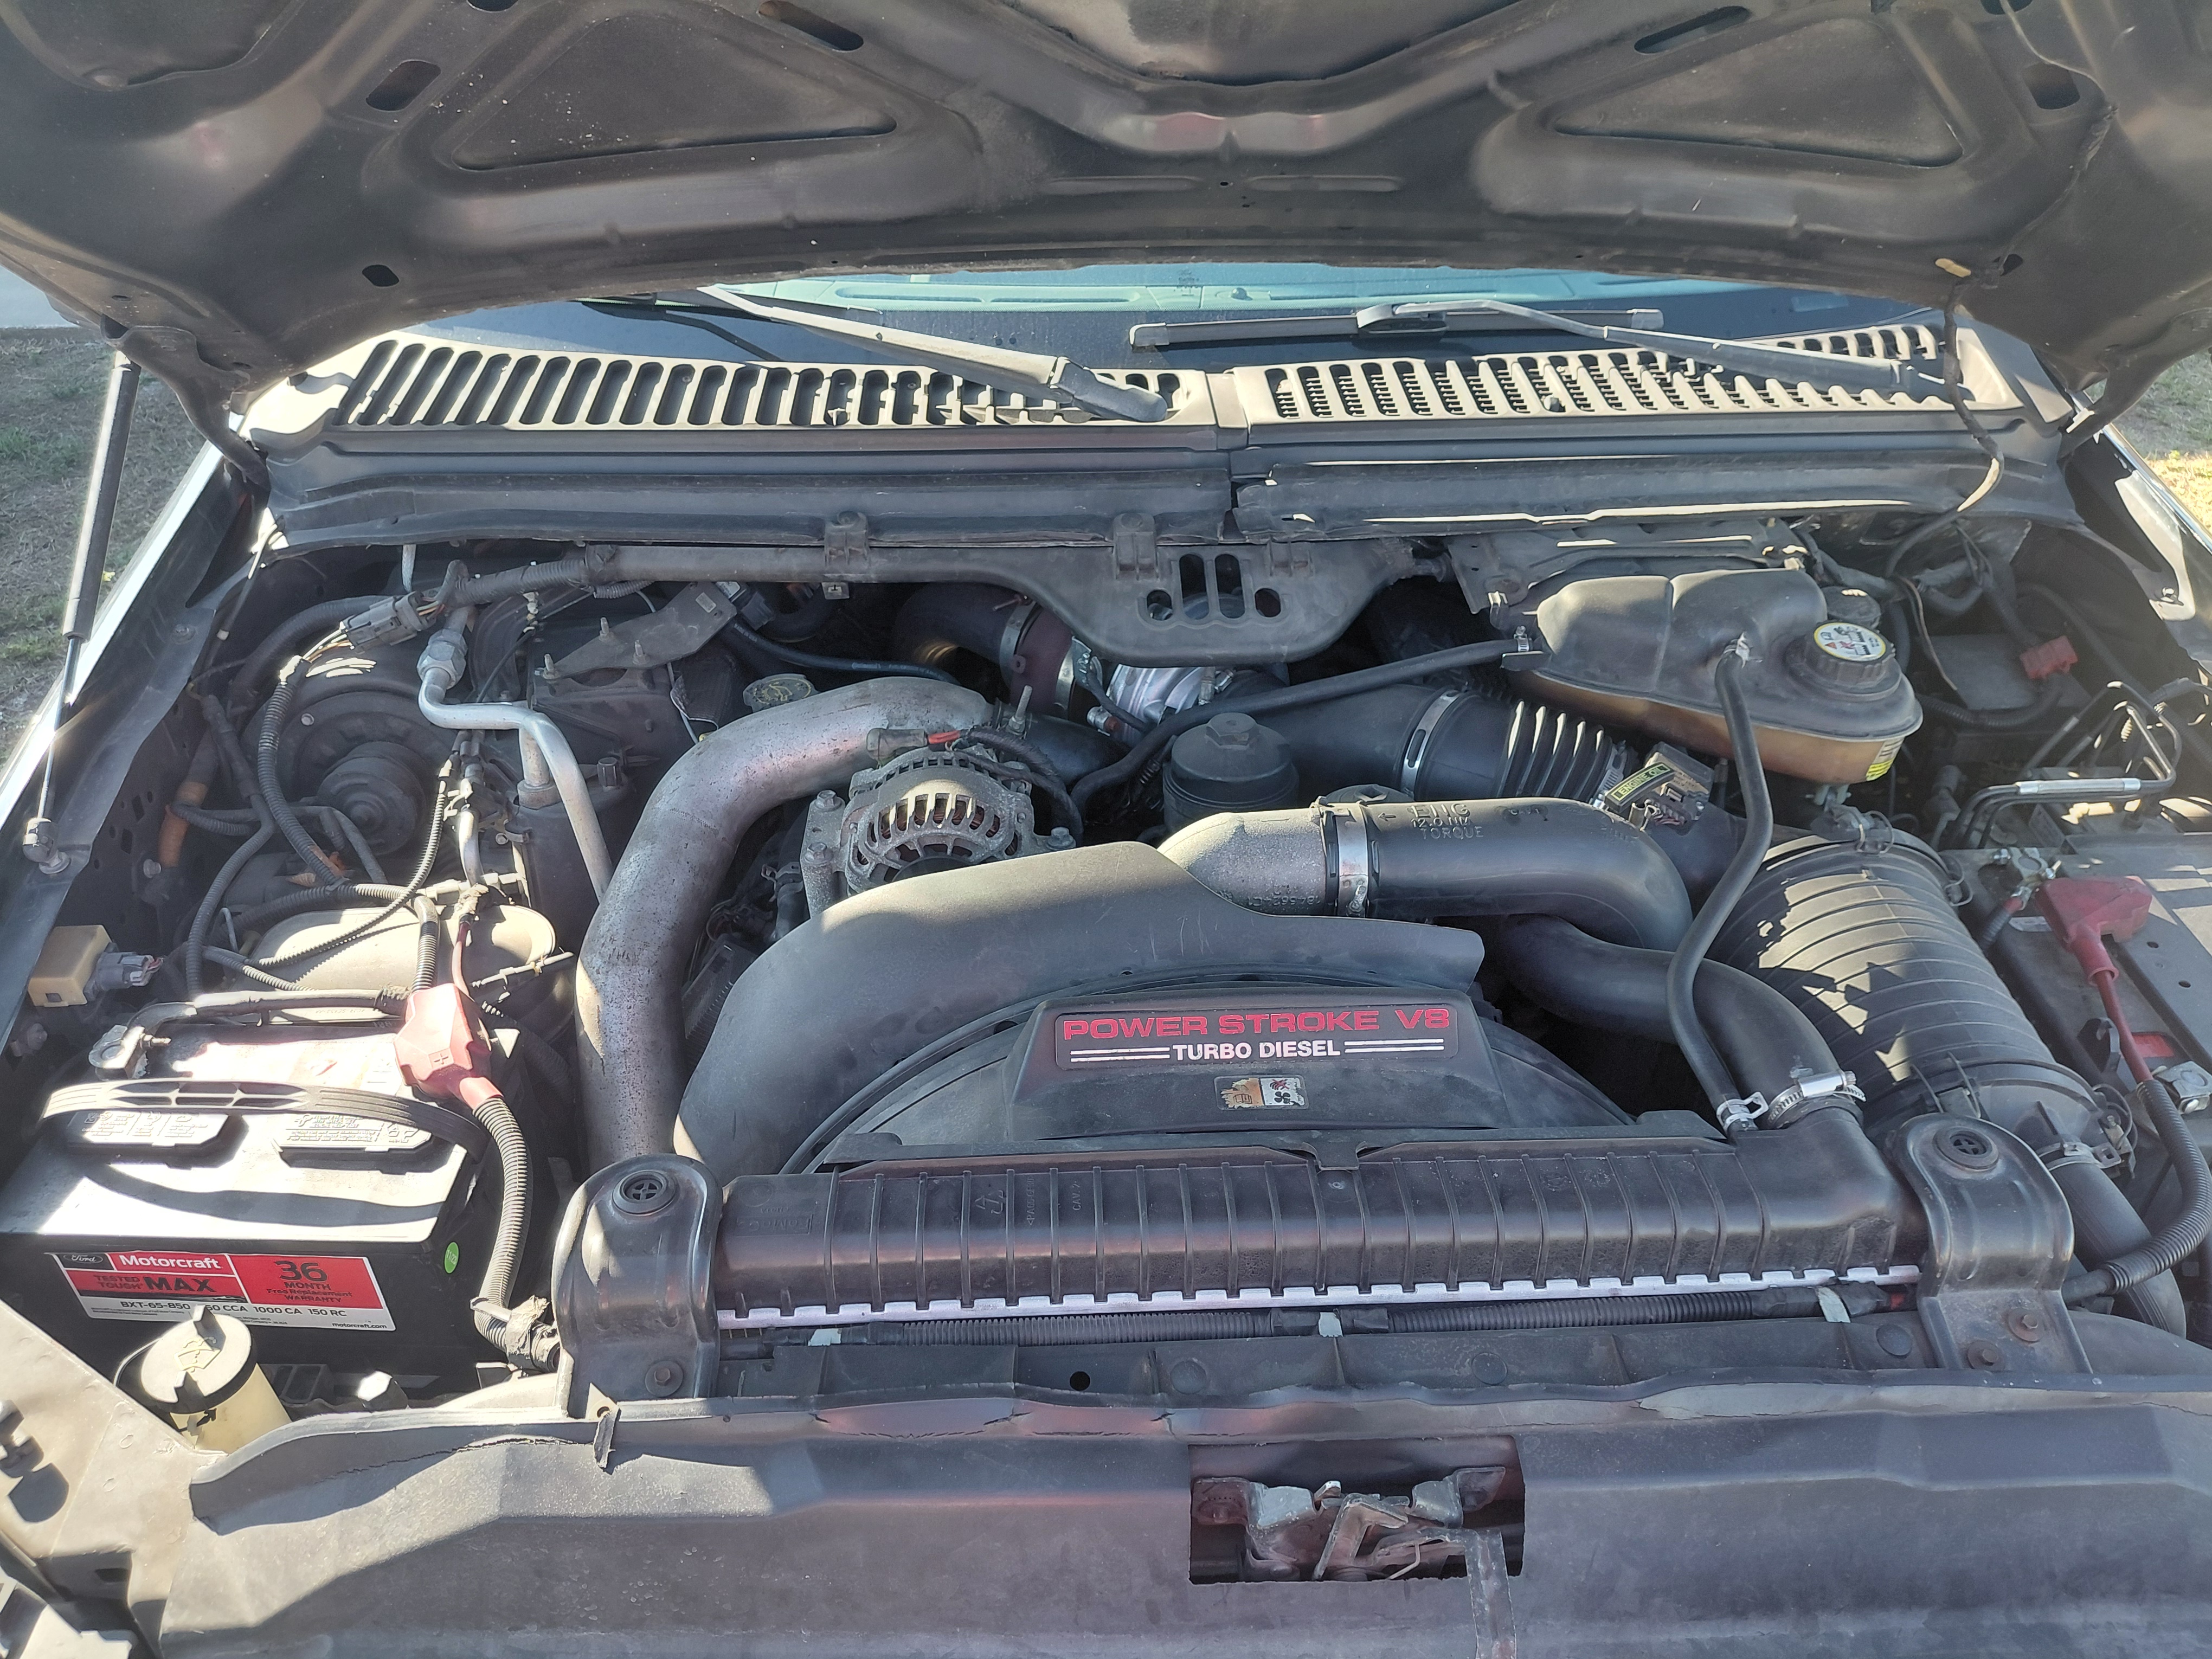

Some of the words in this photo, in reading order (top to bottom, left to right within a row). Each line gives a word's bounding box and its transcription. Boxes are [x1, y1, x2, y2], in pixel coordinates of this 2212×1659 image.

[1618, 773, 1649, 795] ENGINE
[1648, 765, 1665, 780] OIL
[1420, 826, 1484, 840] TORQUE
[1063, 1015, 1208, 1040] POWER
[1218, 1010, 1380, 1034] STROKE
[1394, 1008, 1450, 1029] V8
[1172, 1042, 1252, 1060] TURBO
[1259, 1039, 1341, 1058] DIESEL
[71, 1254, 97, 1263] Ford
[118, 1255, 220, 1269] Motorcraft
[273, 1260, 328, 1282] 36
[93, 1275, 140, 1283] TESTED
[143, 1276, 217, 1293] MAX
[283, 1282, 331, 1290] MONTH
[284, 1294, 342, 1302] WARRANTY
[290, 1289, 353, 1297] Replacement
[120, 1301, 191, 1310] BXT-65-850
